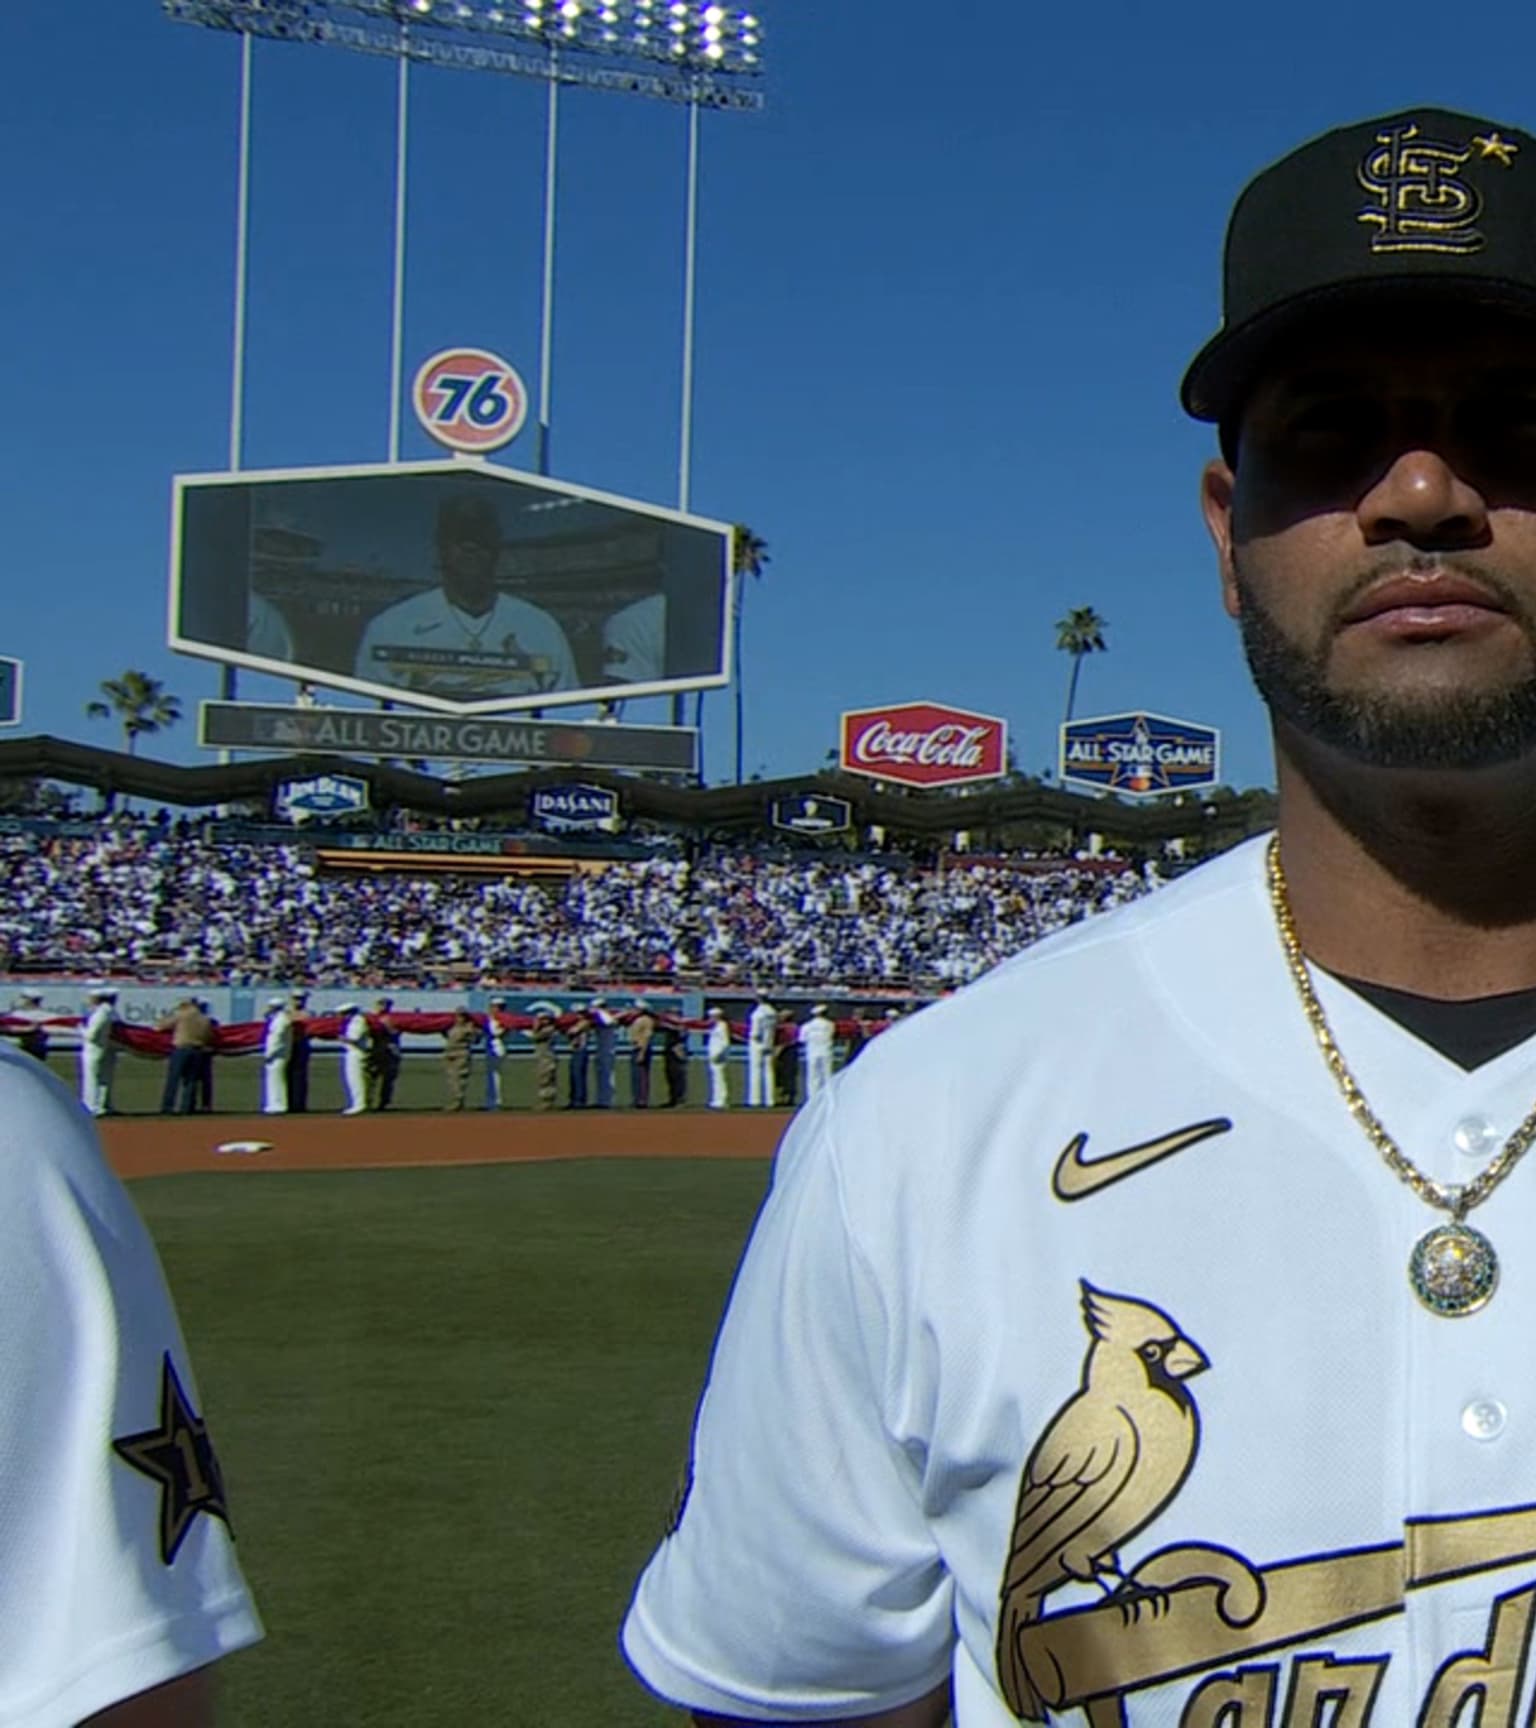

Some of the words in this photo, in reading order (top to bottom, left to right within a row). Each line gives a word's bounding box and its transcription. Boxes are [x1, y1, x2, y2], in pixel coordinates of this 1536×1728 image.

[431, 372, 510, 428] 76
[315, 714, 368, 746] ALL
[379, 718, 451, 750] STAR
[456, 722, 547, 756] GAME
[1068, 741, 1104, 762] ALL
[1108, 740, 1154, 764] STAR
[1155, 741, 1213, 766] GAME
[541, 793, 611, 814] DASANI
[373, 834, 402, 849] ALL
[408, 835, 449, 851] STAR
[452, 836, 500, 854] GAME
